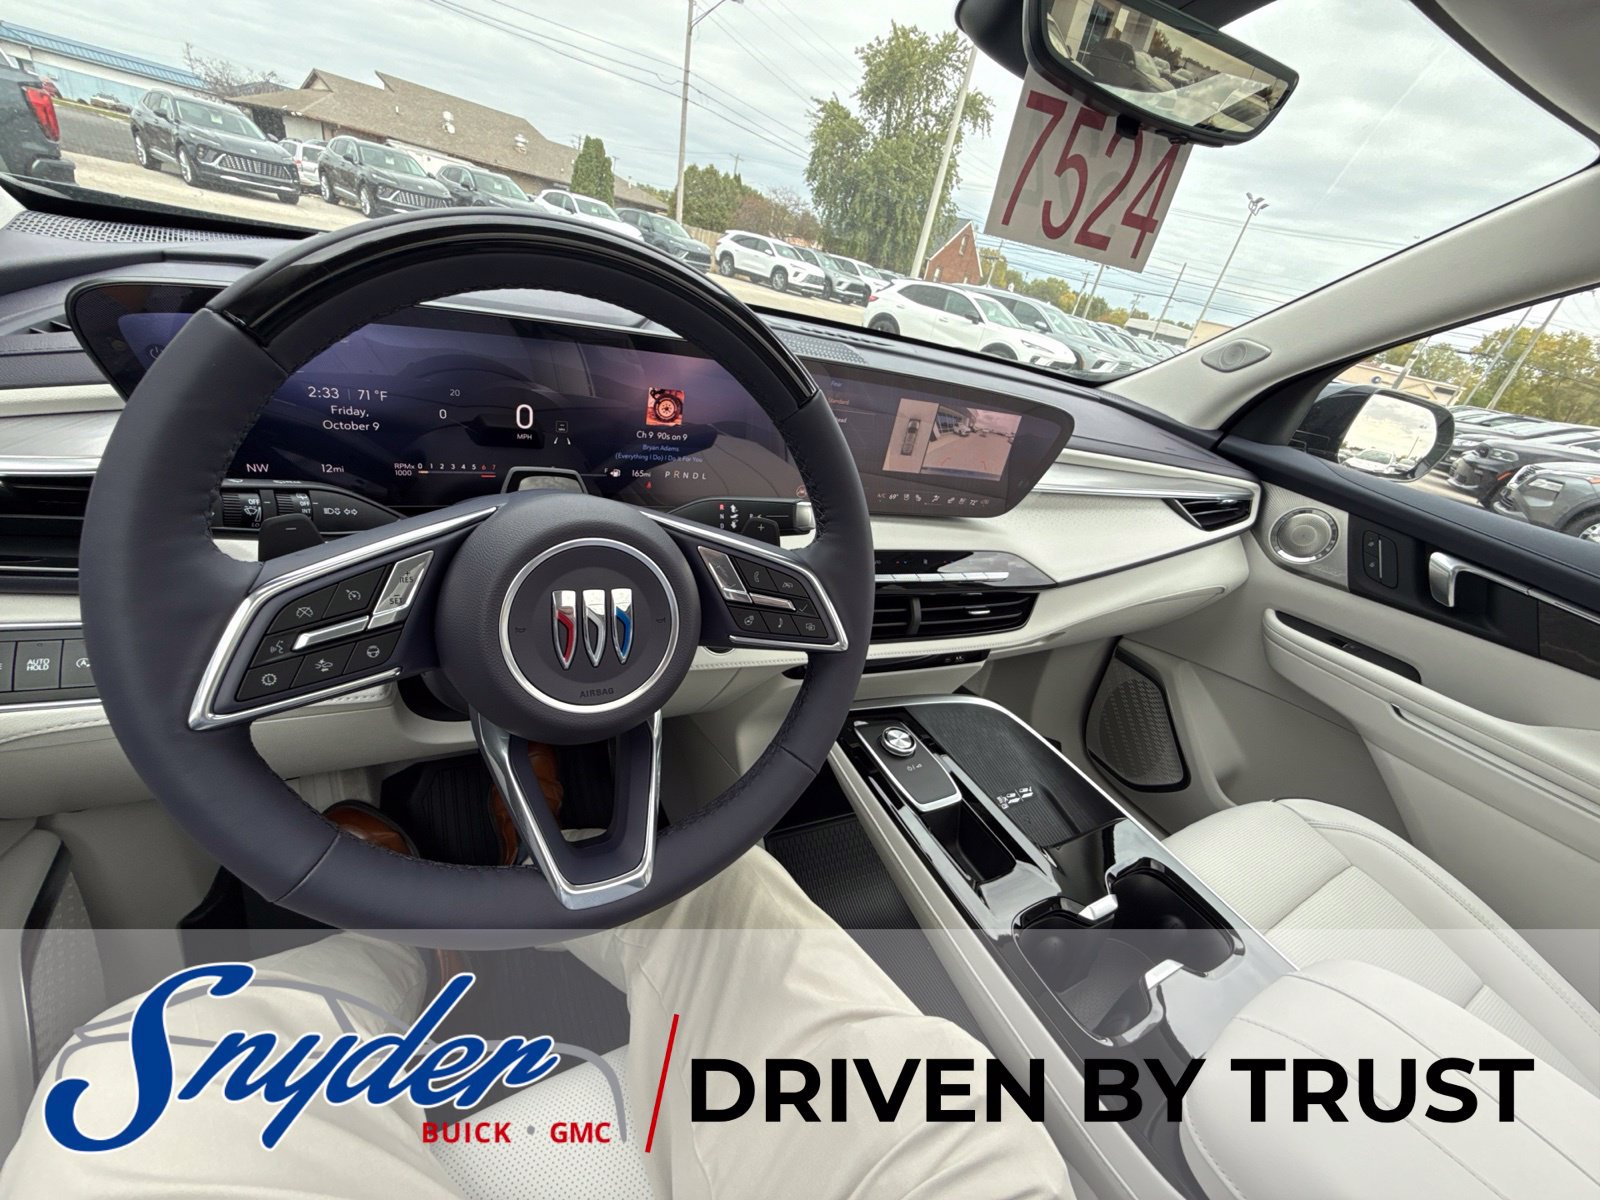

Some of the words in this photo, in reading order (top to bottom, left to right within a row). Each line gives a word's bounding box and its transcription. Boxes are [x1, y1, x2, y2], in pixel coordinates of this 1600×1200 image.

[1001, 90, 1159, 259] 7524
[307, 386, 340, 399] 2:33
[357, 389, 371, 401] 71
[450, 389, 461, 398] 20
[330, 405, 370, 418] Friday,
[438, 409, 448, 420] 0
[516, 404, 534, 430] 0
[322, 420, 370, 431] October
[372, 421, 380, 431] 9
[636, 430, 647, 439] Ch
[648, 431, 654, 439] 9
[657, 432, 671, 440] 90s
[682, 433, 688, 441] 9
[615, 452, 648, 461] (Everything
[246, 463, 269, 473] NW
[320, 464, 345, 474] 12mi
[394, 469, 413, 477] 1000
[665, 471, 671, 479] P
[673, 470, 680, 479] R
[692, 472, 699, 480] D
[579, 687, 615, 699] AIRBAG
